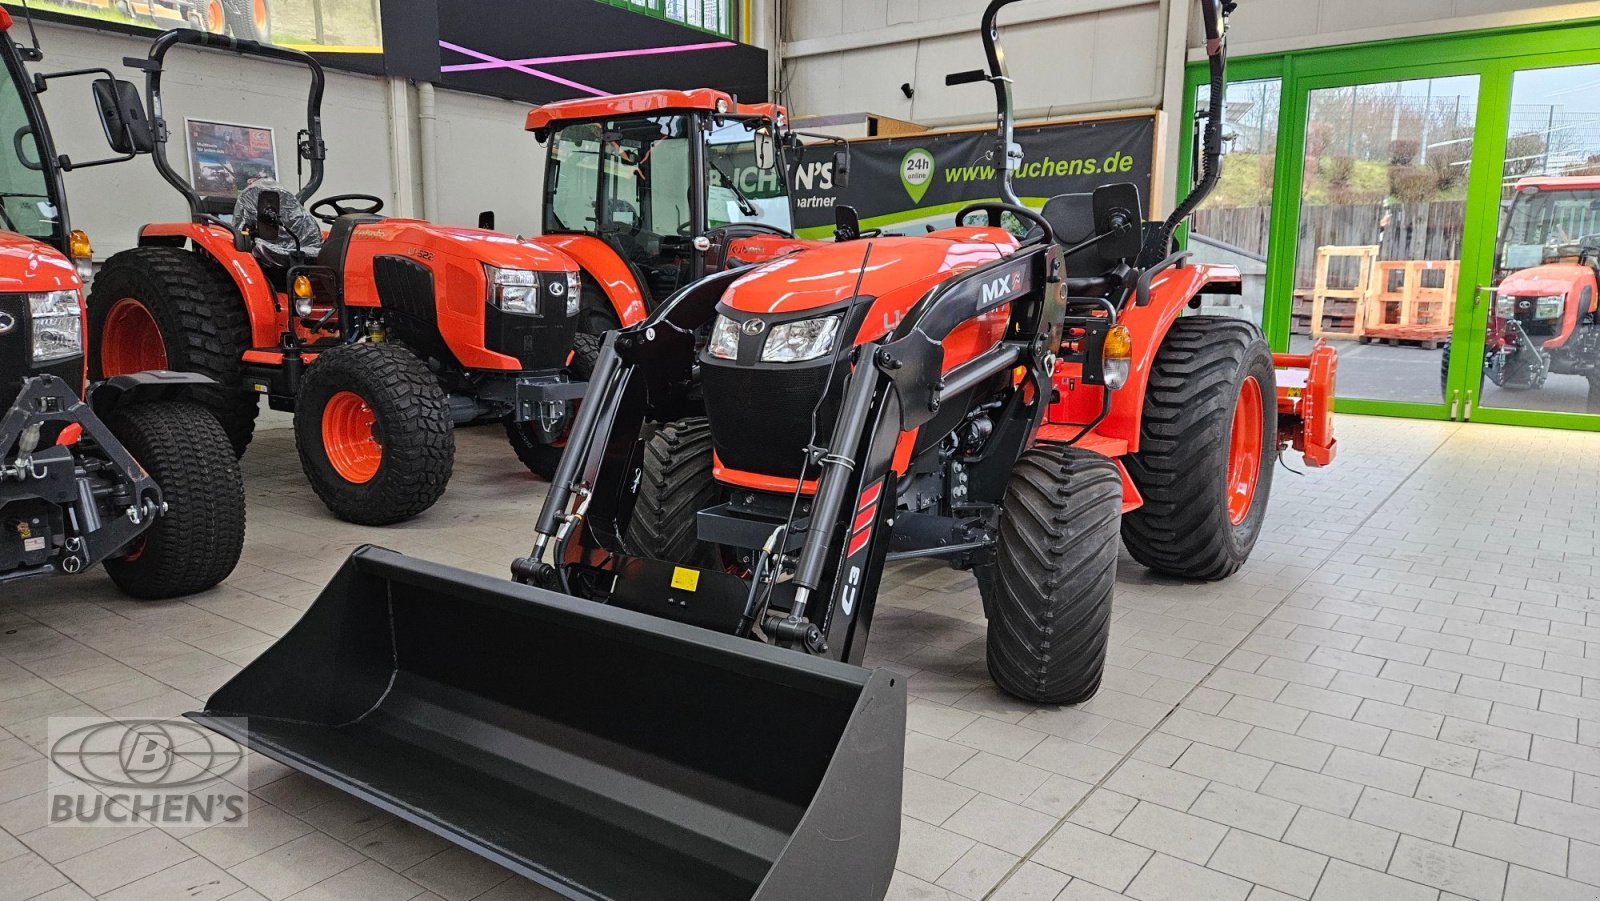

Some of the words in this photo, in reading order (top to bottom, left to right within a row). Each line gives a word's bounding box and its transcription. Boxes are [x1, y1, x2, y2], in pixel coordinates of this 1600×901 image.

[907, 157, 929, 171] 24h
[907, 172, 927, 180] online
[945, 151, 1134, 183] wwwuchens.de
[982, 273, 1012, 304] MX
[841, 565, 861, 616] C3
